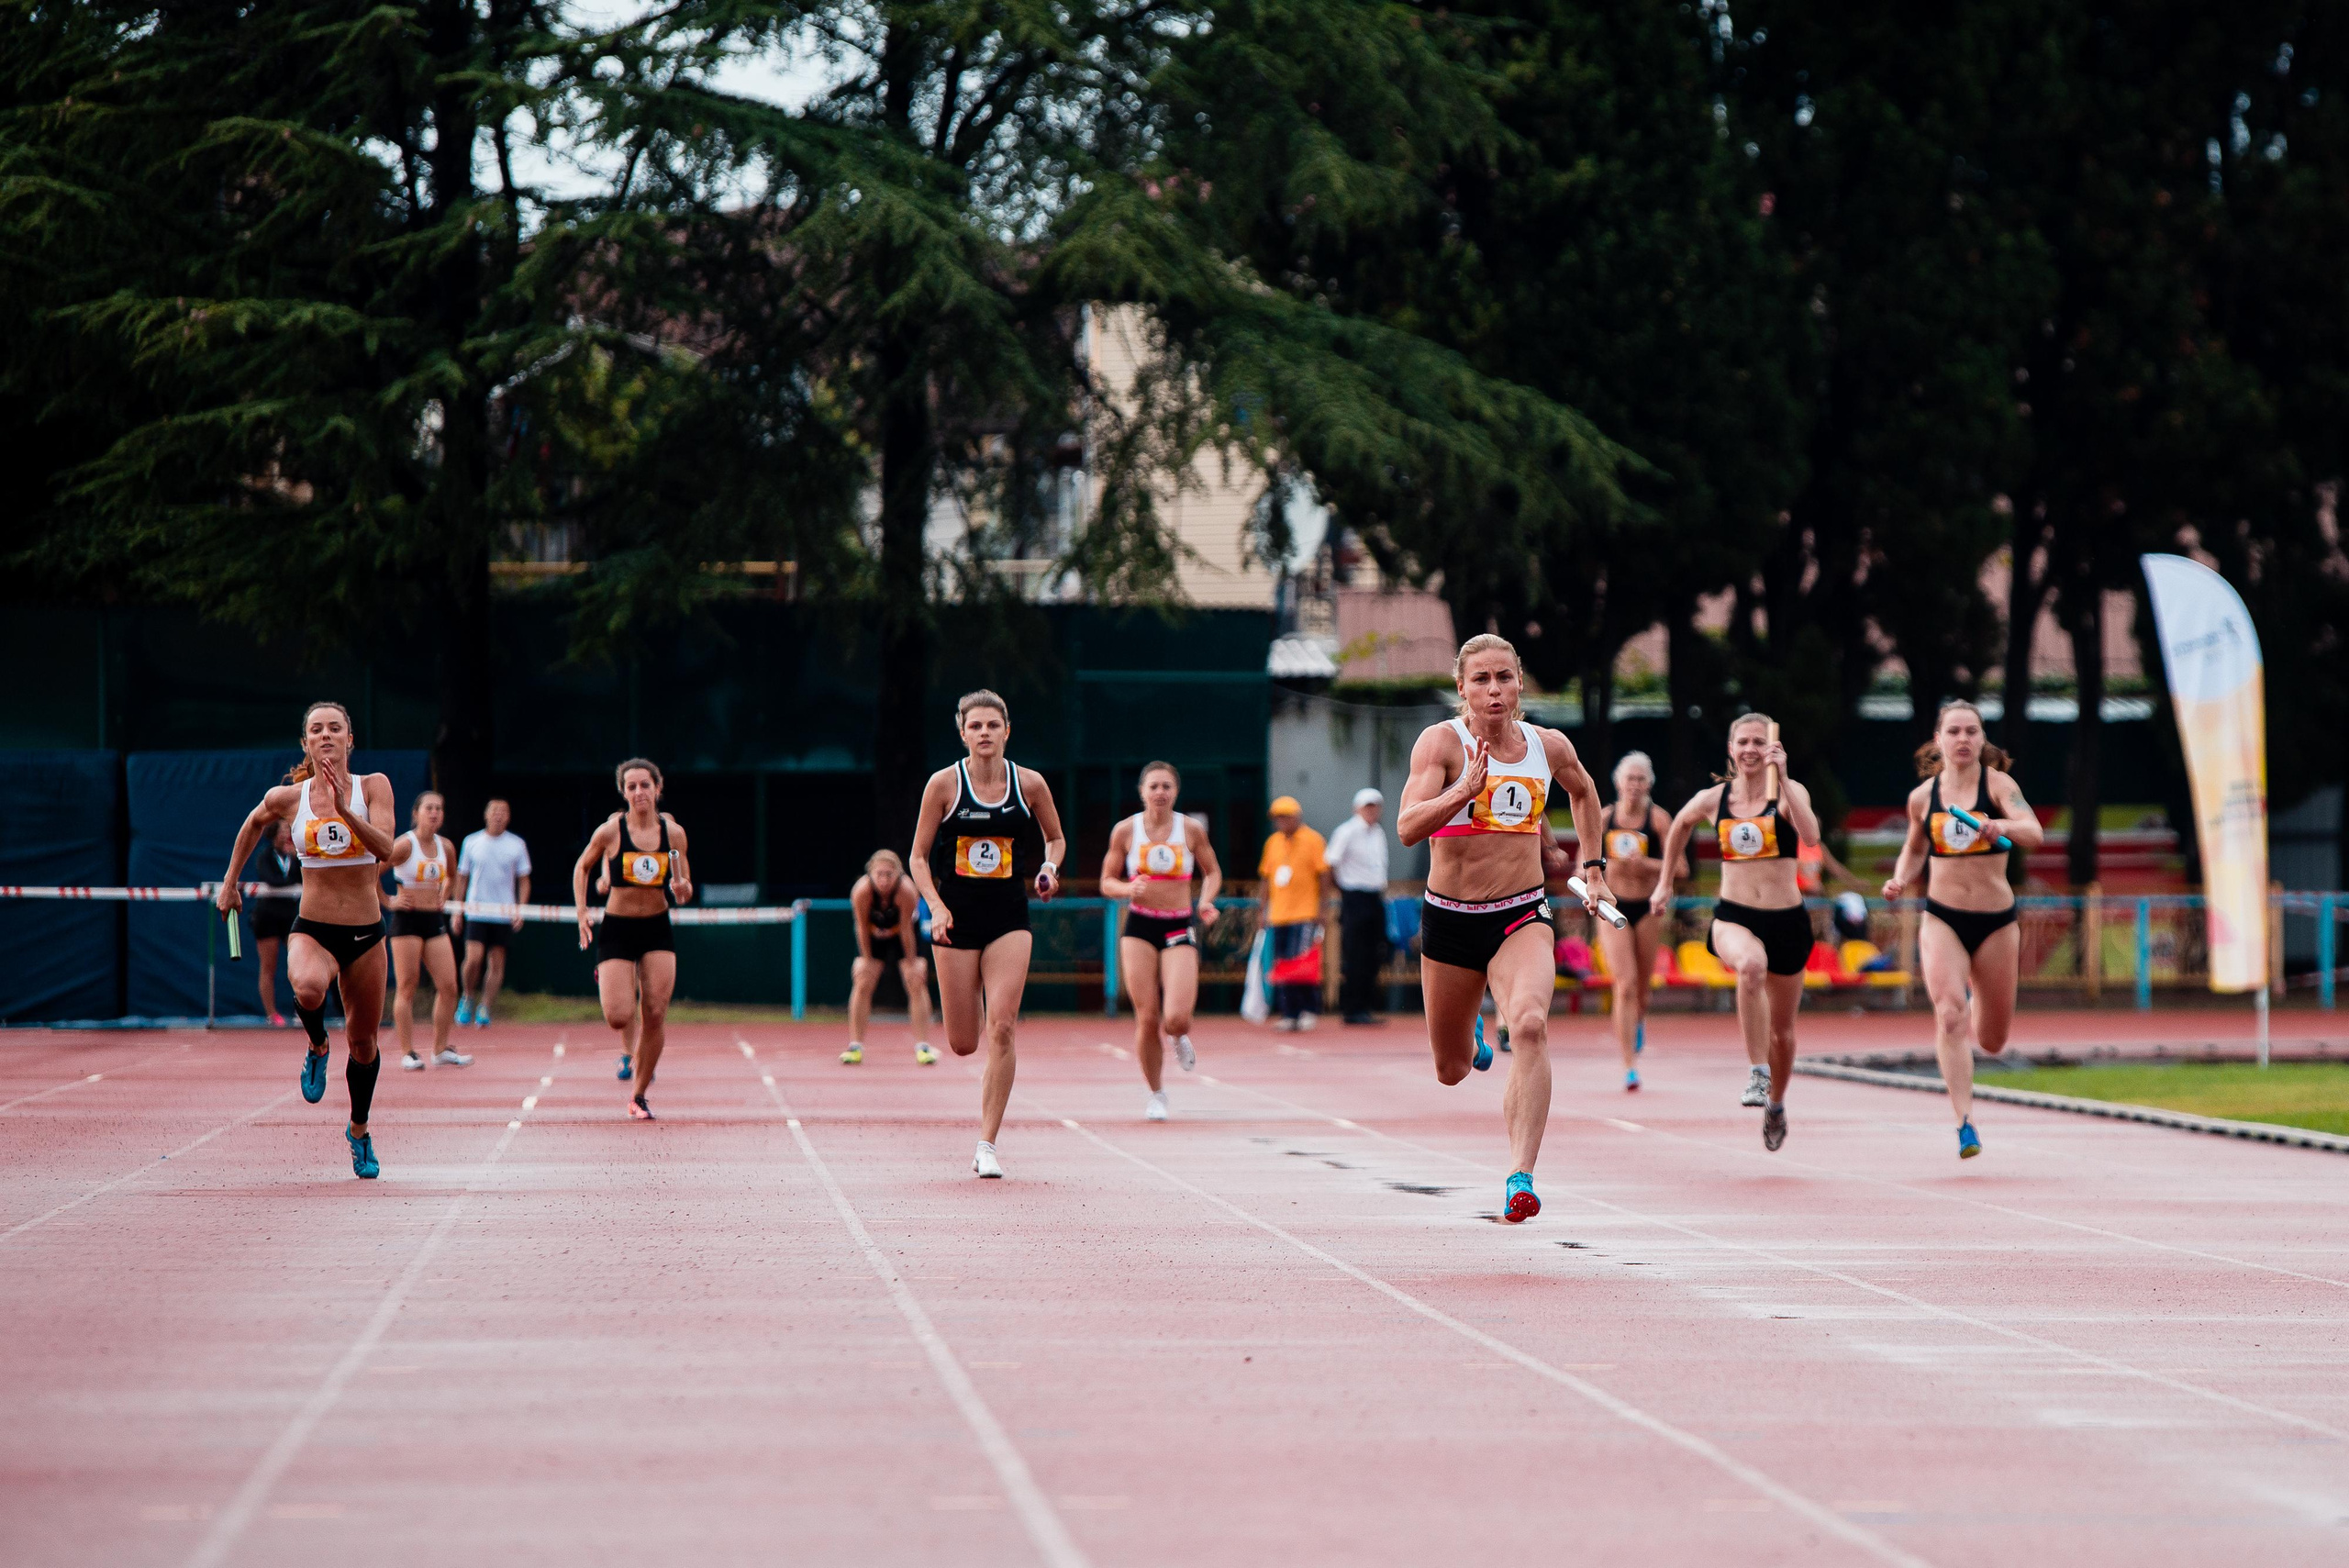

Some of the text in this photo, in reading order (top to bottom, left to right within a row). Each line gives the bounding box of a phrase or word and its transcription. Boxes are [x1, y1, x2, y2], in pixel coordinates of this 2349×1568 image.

[1506, 786, 1515, 806] 1
[1516, 801, 1522, 811] 4
[328, 826, 338, 840] 5
[1742, 826, 1750, 841] 3
[980, 842, 990, 859] 2
[642, 858, 650, 871] 4
